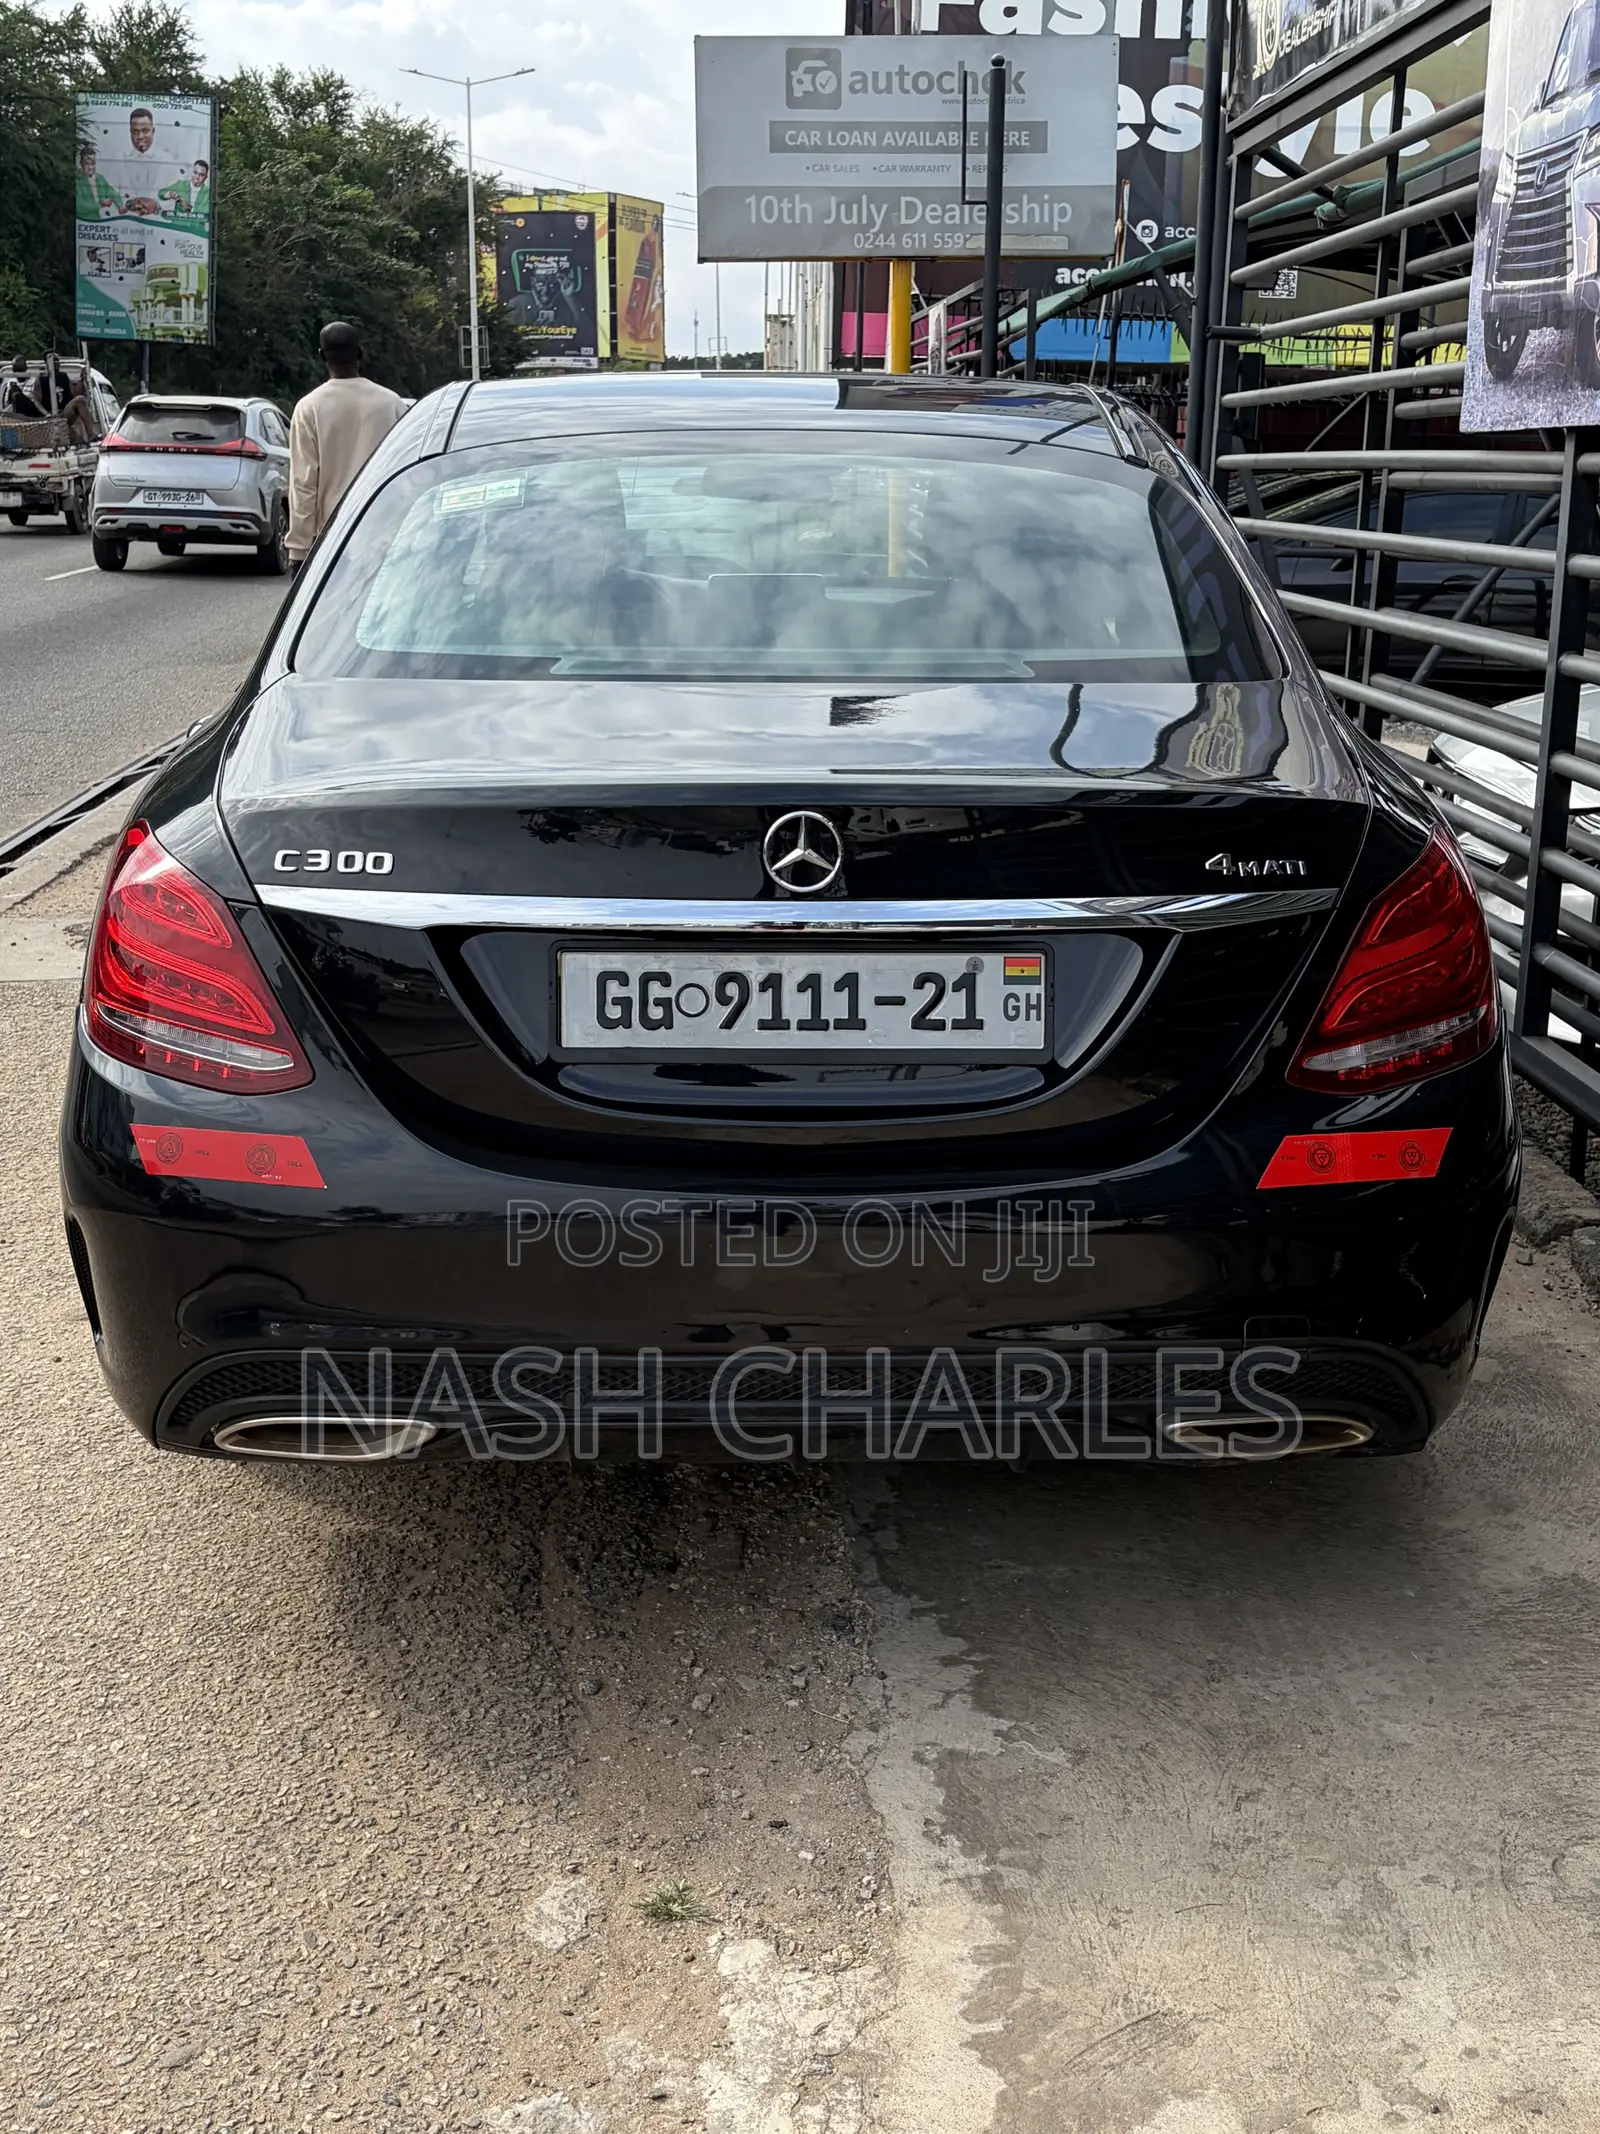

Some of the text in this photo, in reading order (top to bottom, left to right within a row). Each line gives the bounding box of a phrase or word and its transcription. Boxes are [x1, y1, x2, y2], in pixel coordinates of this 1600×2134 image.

[169, 95, 211, 105] HOSPITAL
[785, 130, 1030, 147] CAR LOAN AVAILABE ERE
[812, 164, 860, 173] CAR SALES
[878, 164, 952, 173] CAR WARRANTY
[972, 164, 1008, 173] REPS
[744, 194, 1073, 233] 10th July Dealeship
[78, 224, 111, 233] EXPERT
[77, 232, 119, 241] DISEASES
[853, 233, 966, 249] 0244 611 559
[273, 848, 395, 875] C300
[599, 970, 985, 1031] GG 9111-21
[1003, 992, 1042, 1022] GH
